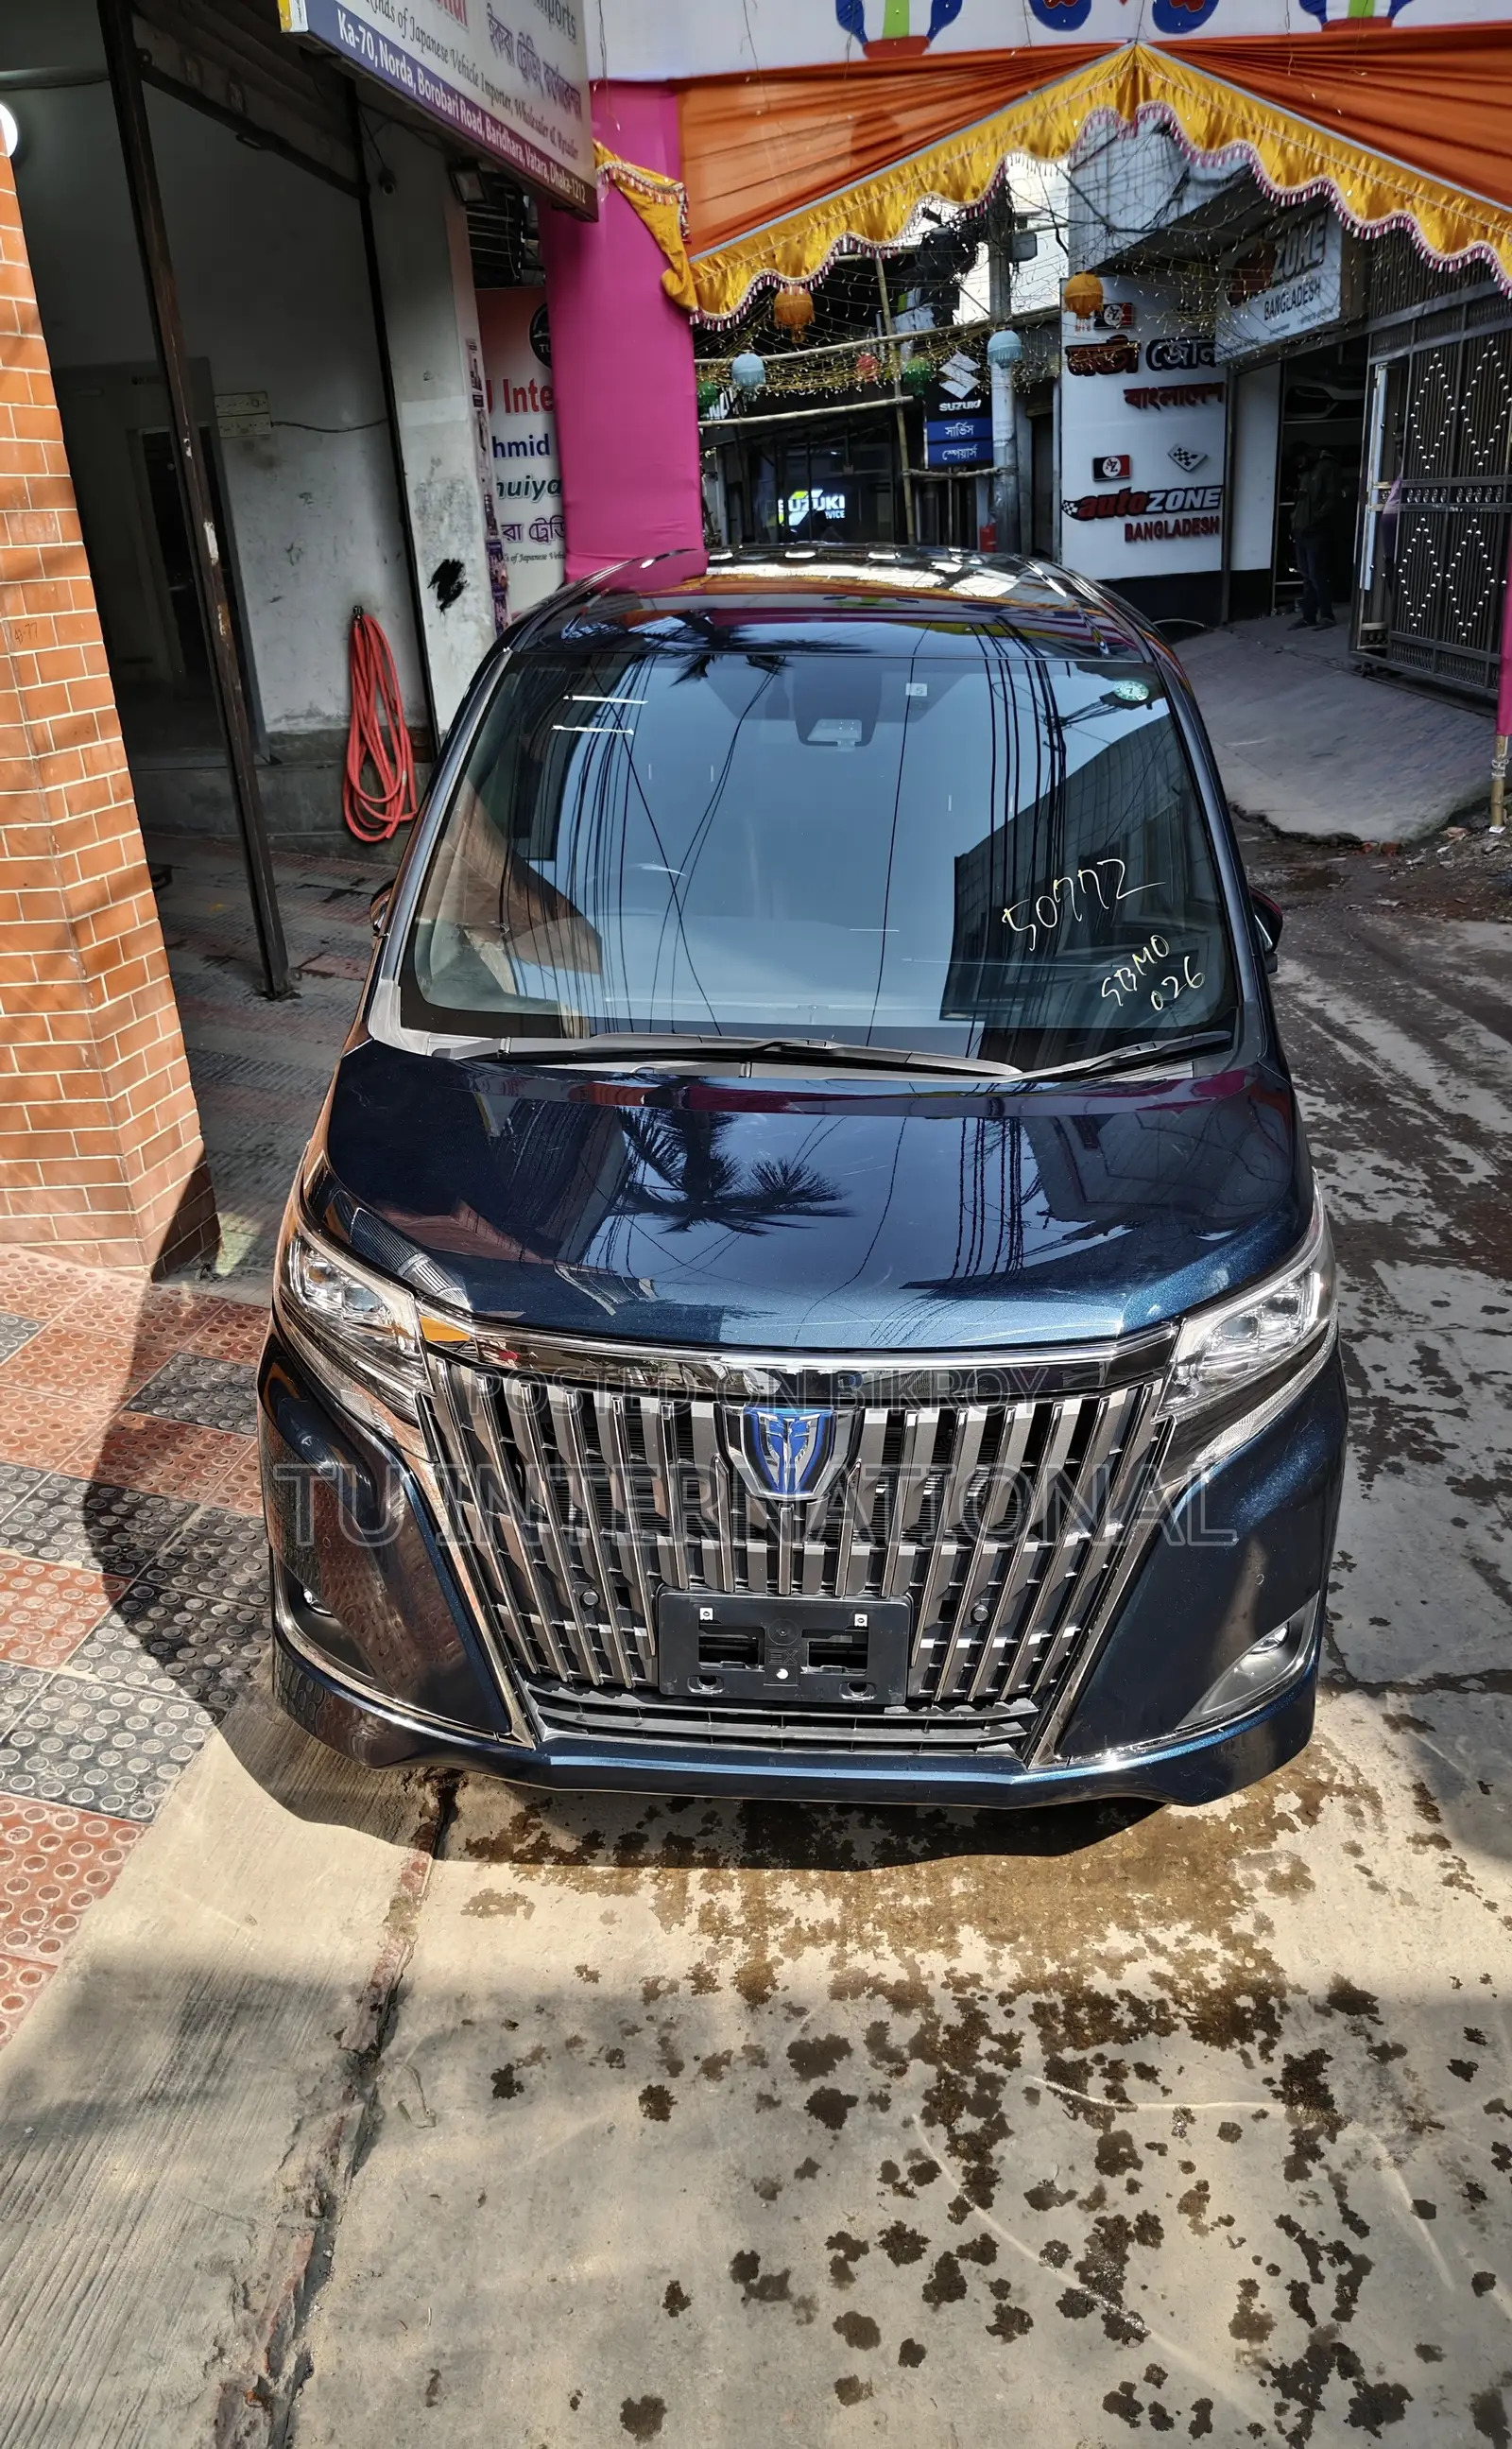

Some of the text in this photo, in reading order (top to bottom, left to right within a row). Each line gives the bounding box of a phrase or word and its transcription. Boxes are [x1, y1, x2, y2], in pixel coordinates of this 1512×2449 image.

[536, 0, 576, 40] mports
[397, 8, 408, 39] of
[409, 17, 449, 63] Japanese
[450, 49, 479, 87] Vehicle
[480, 72, 514, 116] Importer,
[337, 9, 379, 67] Ka-70,
[379, 40, 417, 95] Norda,
[417, 67, 459, 120] Borobari
[459, 99, 485, 141] Road,
[485, 117, 525, 167] Baridhara,
[525, 144, 550, 183] Vatara,
[550, 162, 586, 204] Dhaka-1212
[1263, 276, 1321, 320] BANGLADESH
[503, 378, 555, 413] Inte
[938, 399, 982, 412] SUZUKI
[1124, 382, 1226, 410] বাংলাদেশ
[945, 422, 974, 438] সার্ভিস
[491, 434, 550, 457] hmid
[496, 475, 561, 500] uiya
[825, 509, 846, 520] VICE
[1076, 486, 1223, 521] autoZONE
[501, 524, 522, 541] রা
[1125, 516, 1220, 543] BANGLADESH
[519, 554, 547, 564] Japanese
[1002, 858, 1167, 952] 50772
[1151, 956, 1206, 1011] 026
[768, 1649, 799, 1664] EX
